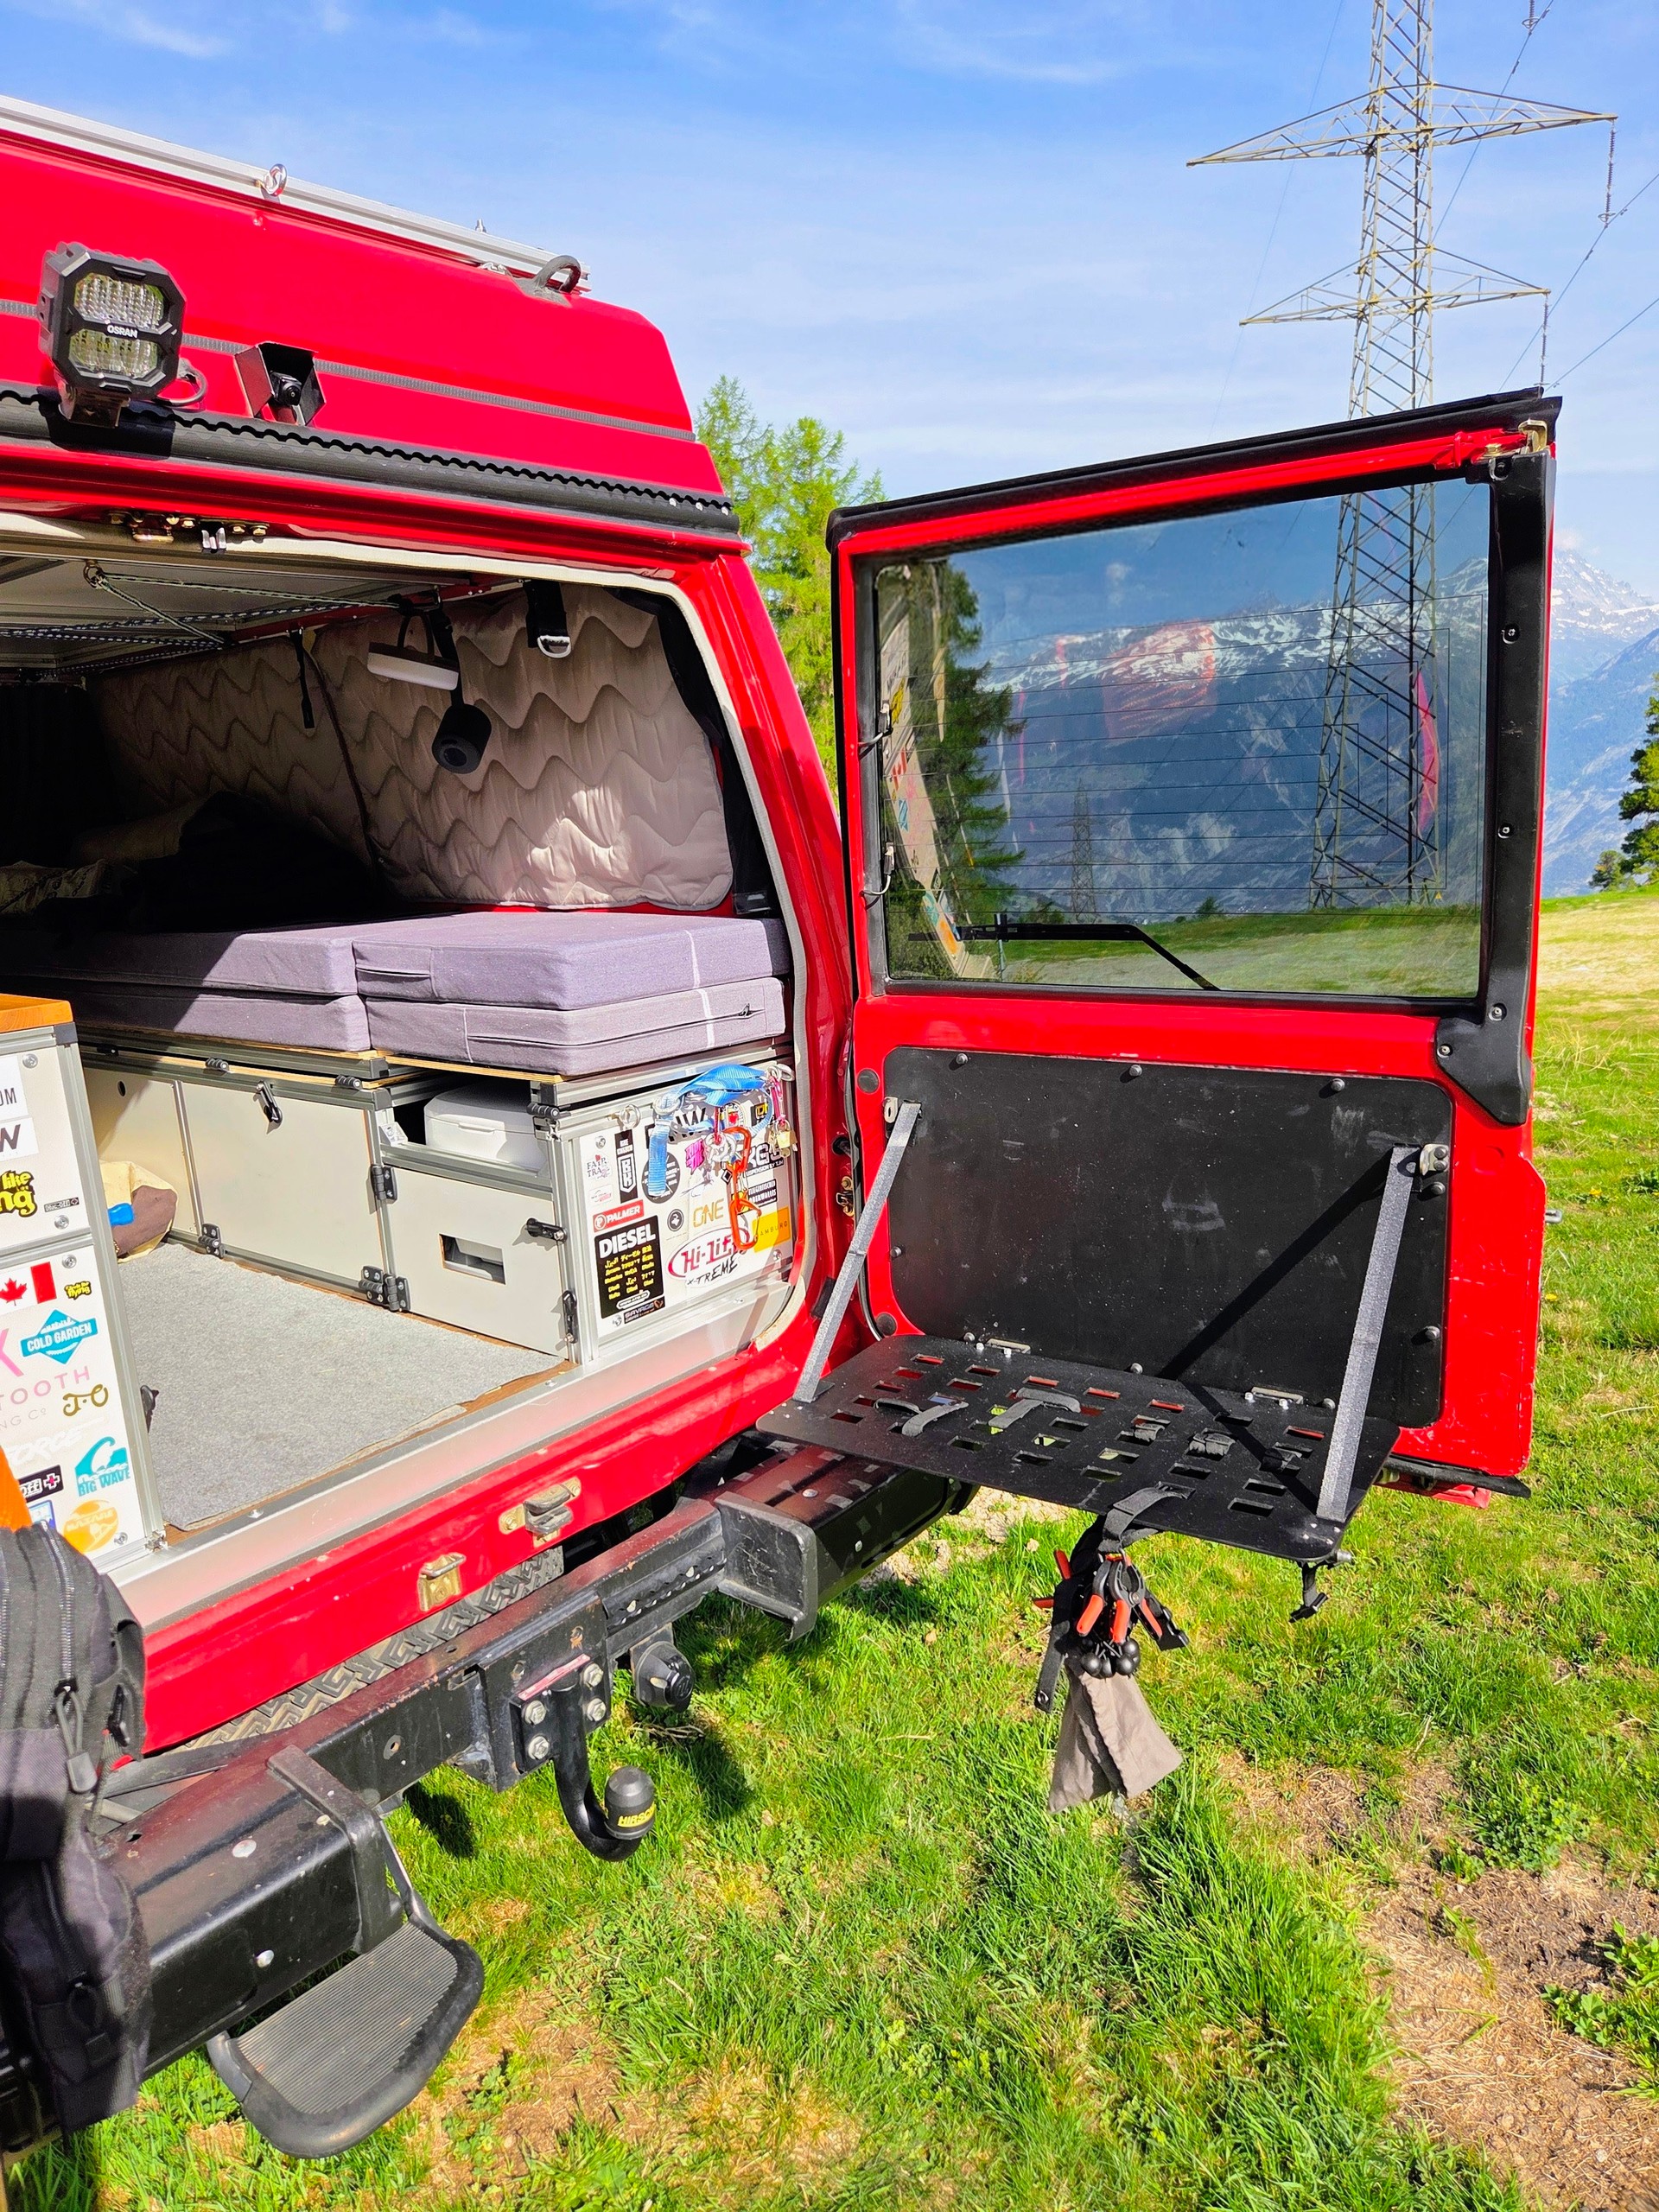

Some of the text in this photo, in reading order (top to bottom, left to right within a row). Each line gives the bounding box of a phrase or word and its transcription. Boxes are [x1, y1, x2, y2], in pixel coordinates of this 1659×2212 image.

[607, 1205, 641, 1224] PALMER
[599, 1224, 657, 1259] DIESEL
[27, 1336, 53, 1352] COLD
[54, 1322, 93, 1344] GARDEN
[79, 1480, 97, 1497] BIG
[99, 1469, 130, 1489] WAVE
